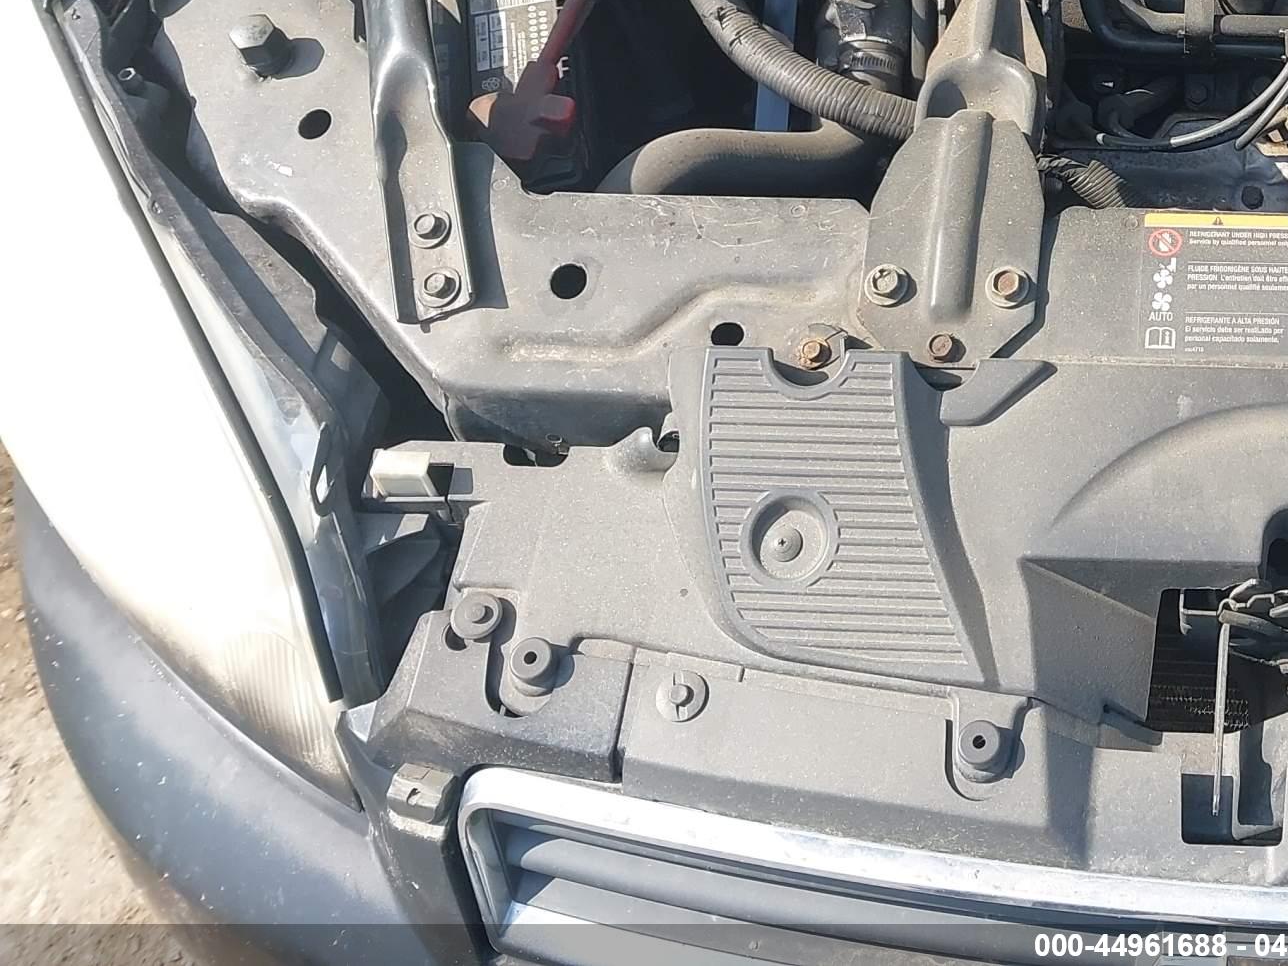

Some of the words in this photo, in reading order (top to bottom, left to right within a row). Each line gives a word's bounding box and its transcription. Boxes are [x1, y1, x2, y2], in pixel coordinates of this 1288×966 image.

[1187, 265, 1209, 273] FLUIDE
[1148, 312, 1174, 321] AUTO
[1185, 316, 1231, 324] REFRIGERANTE
[1184, 325, 1191, 333] El
[1184, 335, 1211, 343] personal
